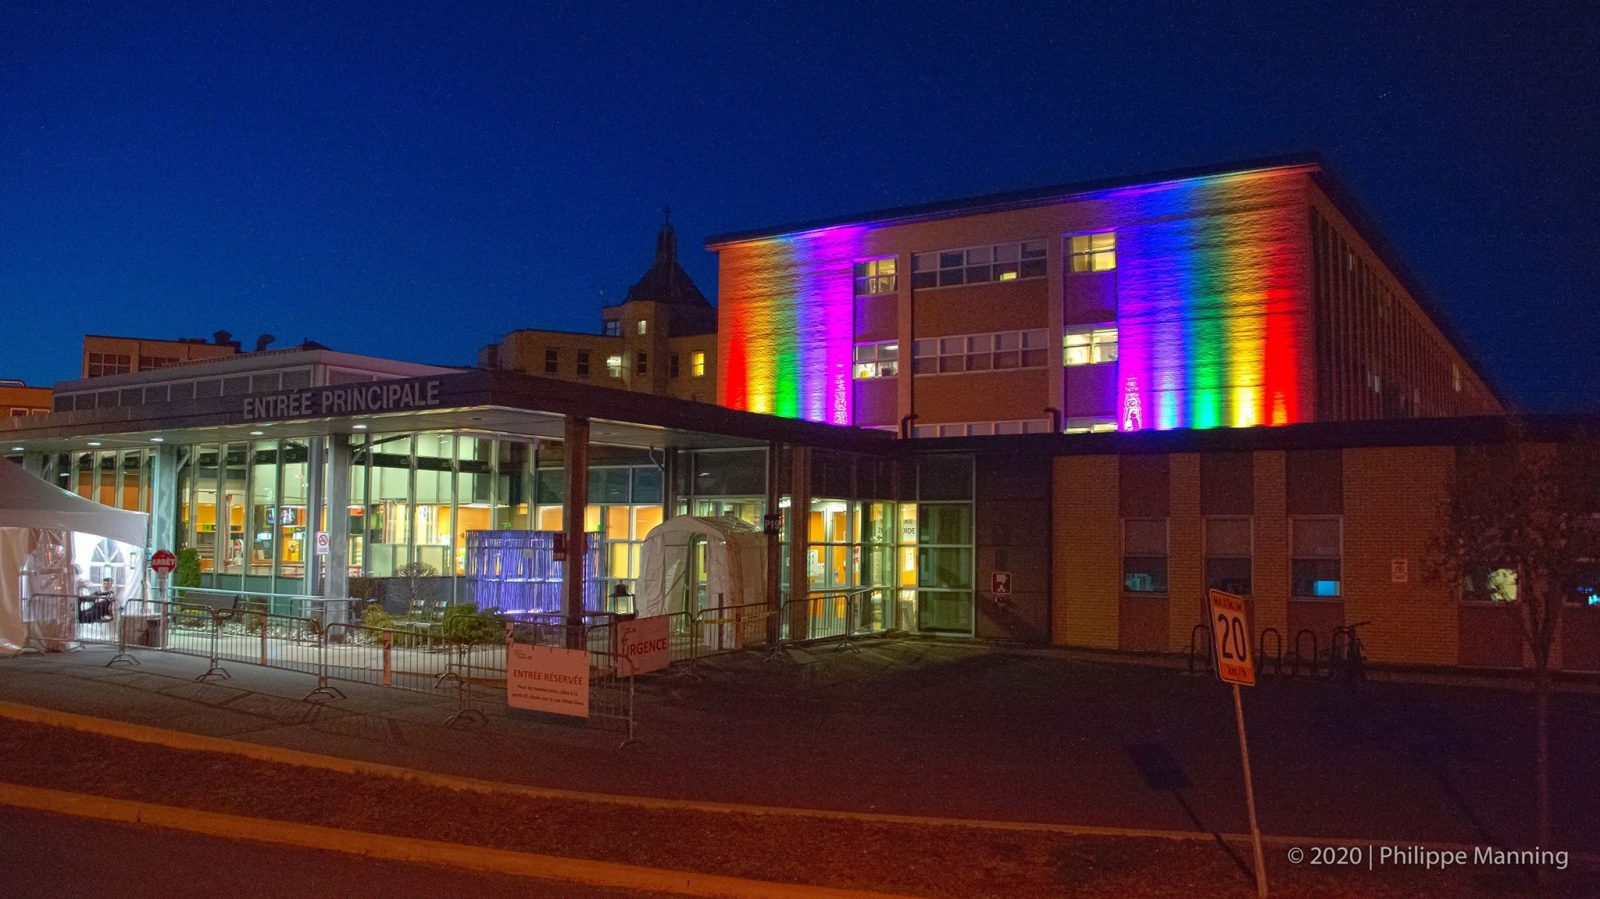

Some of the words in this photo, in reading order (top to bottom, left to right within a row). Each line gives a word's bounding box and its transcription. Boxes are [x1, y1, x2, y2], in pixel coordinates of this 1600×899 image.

[243, 388, 313, 420] ENTRÉE
[322, 380, 440, 414] PRINCIPALE
[152, 557, 175, 566] ARRÊT
[622, 637, 668, 657] URGENCE
[1218, 613, 1247, 662] 20
[513, 669, 543, 681] ENTRÉE
[544, 671, 584, 686] RÉSERVÉE
